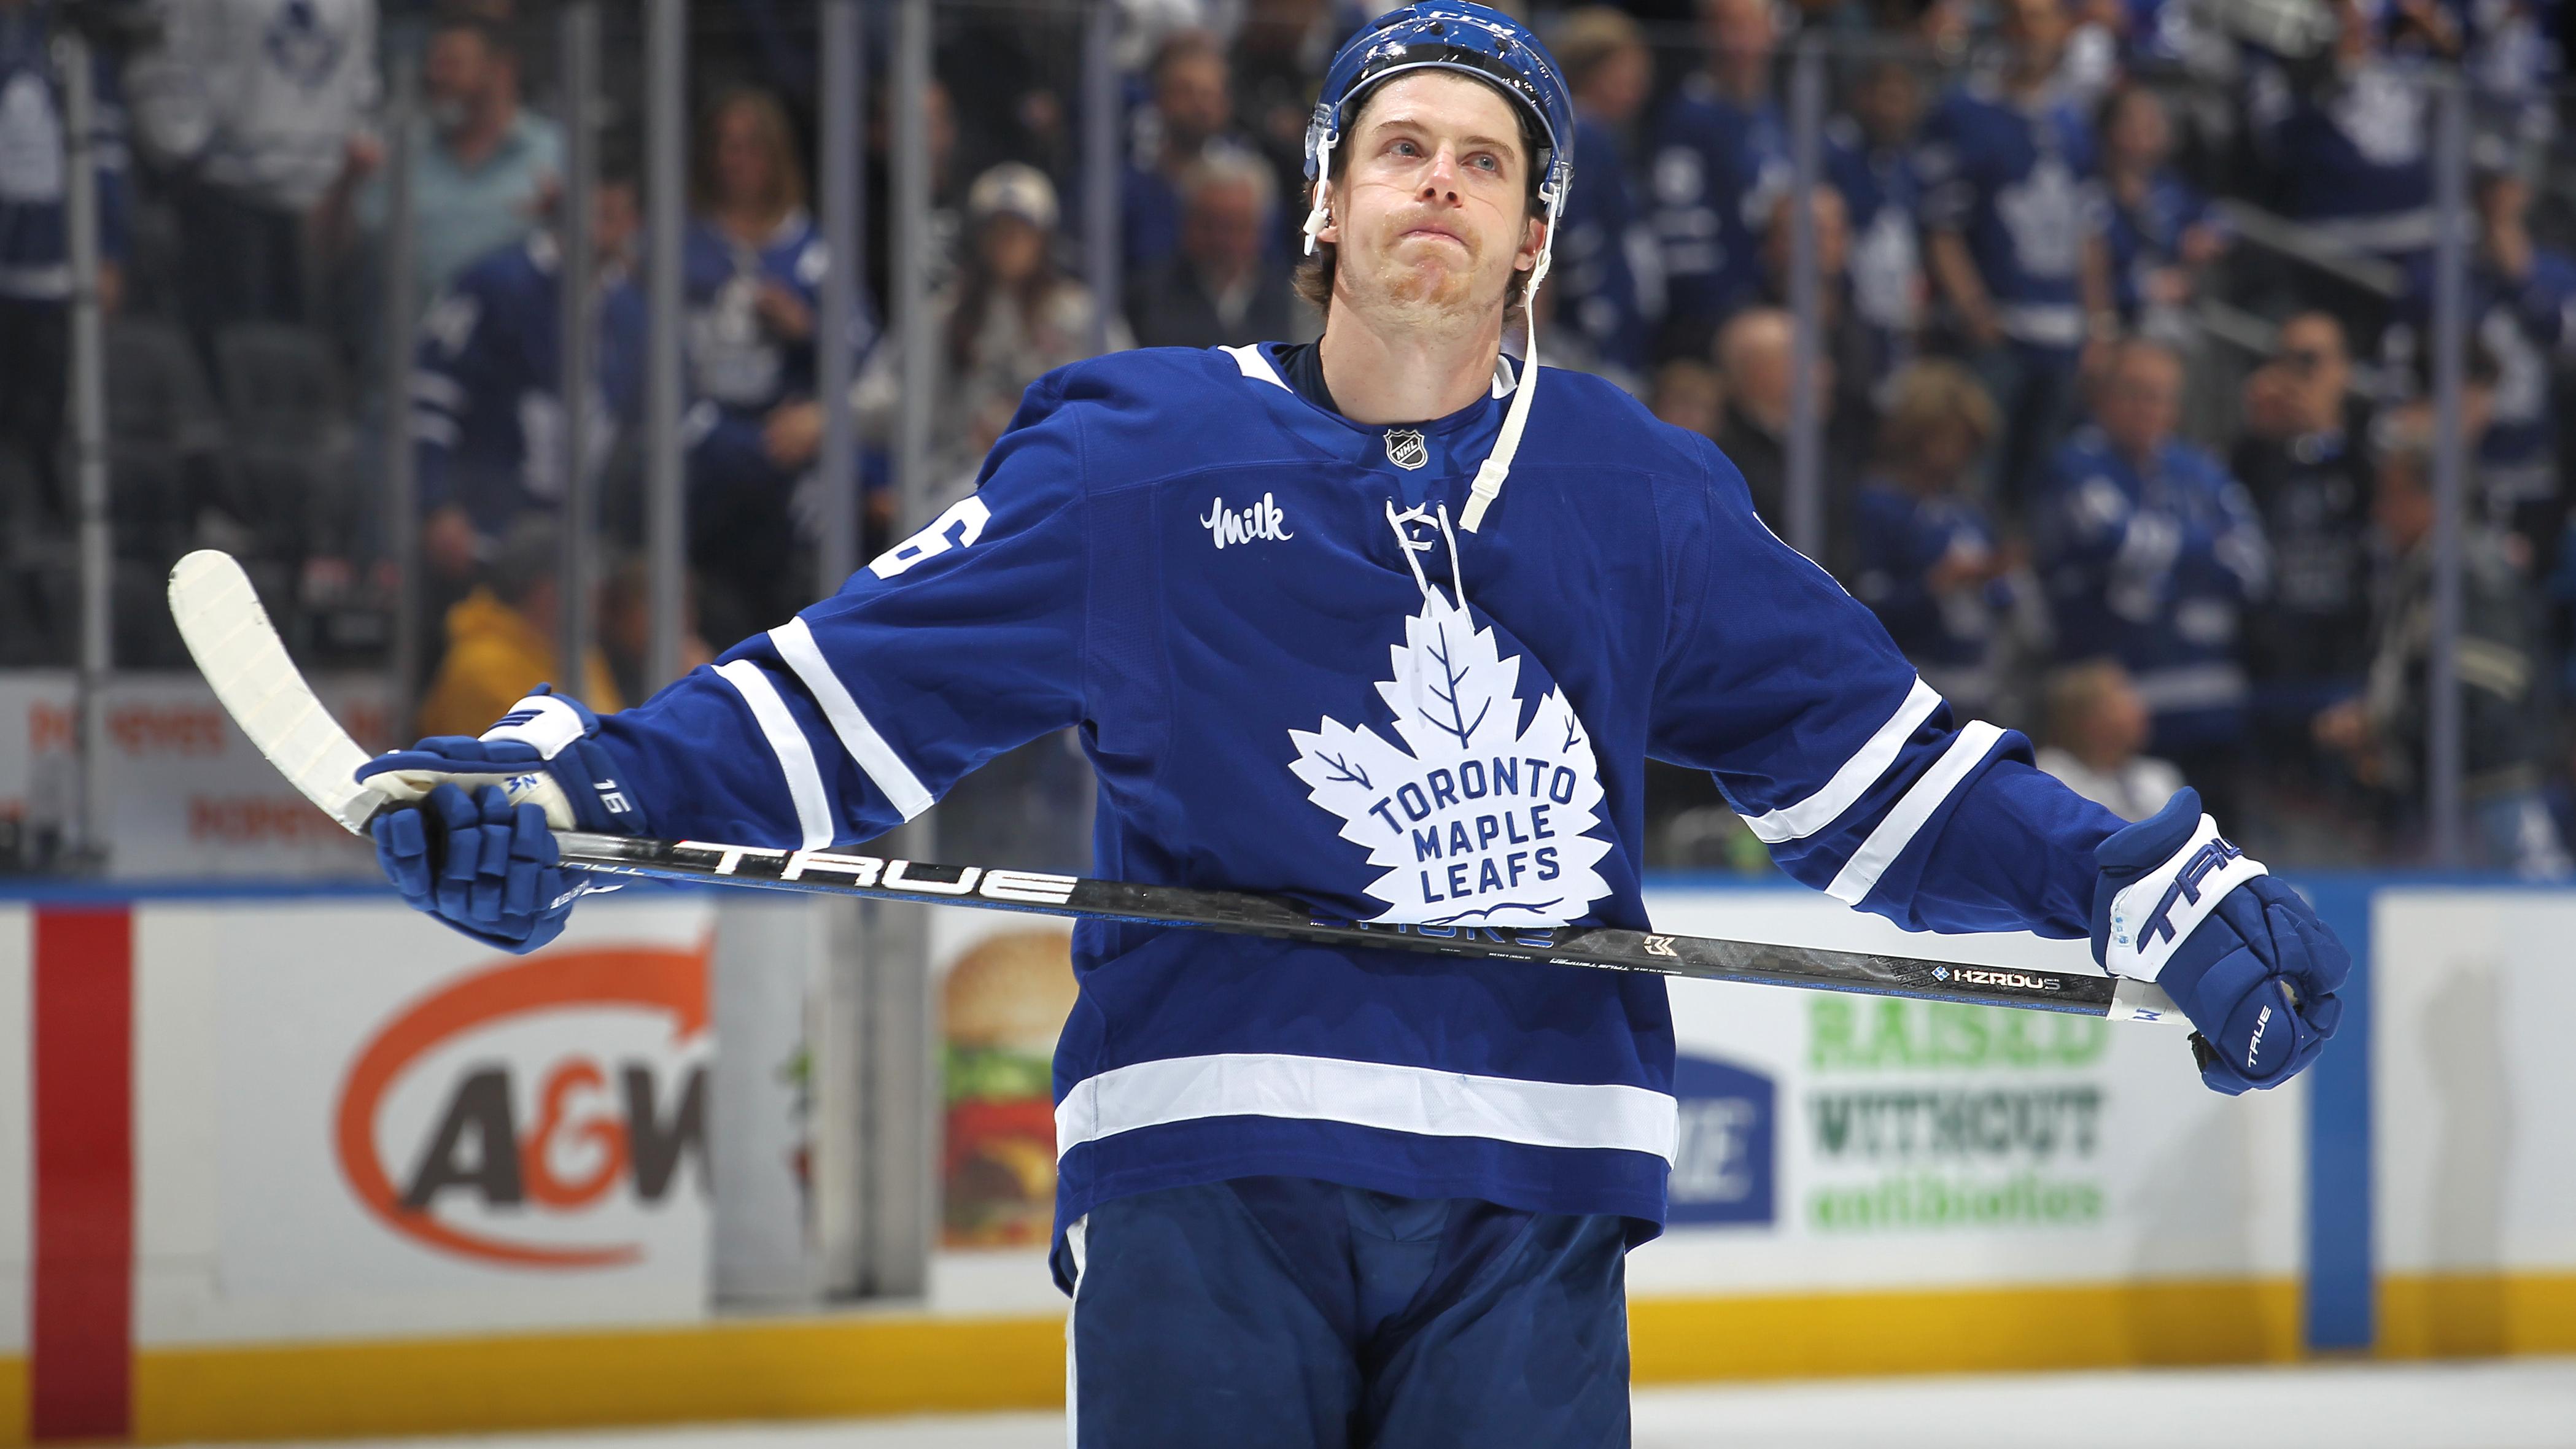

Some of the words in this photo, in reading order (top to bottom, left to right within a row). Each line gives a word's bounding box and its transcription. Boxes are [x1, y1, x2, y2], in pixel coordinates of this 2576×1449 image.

[1395, 440, 1418, 461] NHL
[1200, 492, 1294, 549] Milk
[593, 779, 633, 814] 16
[1369, 756, 1577, 835] TORONTO
[1412, 804, 1556, 862] MAPLE
[673, 839, 1079, 905] TRUE
[1420, 846, 1561, 905] LEAFS
[2136, 837, 2245, 955] TRU
[1953, 968, 2061, 991] HZRDUS
[1809, 993, 2107, 1068] RAISED
[2248, 1005, 2272, 1068] TRUE
[398, 1053, 712, 1215] A&W
